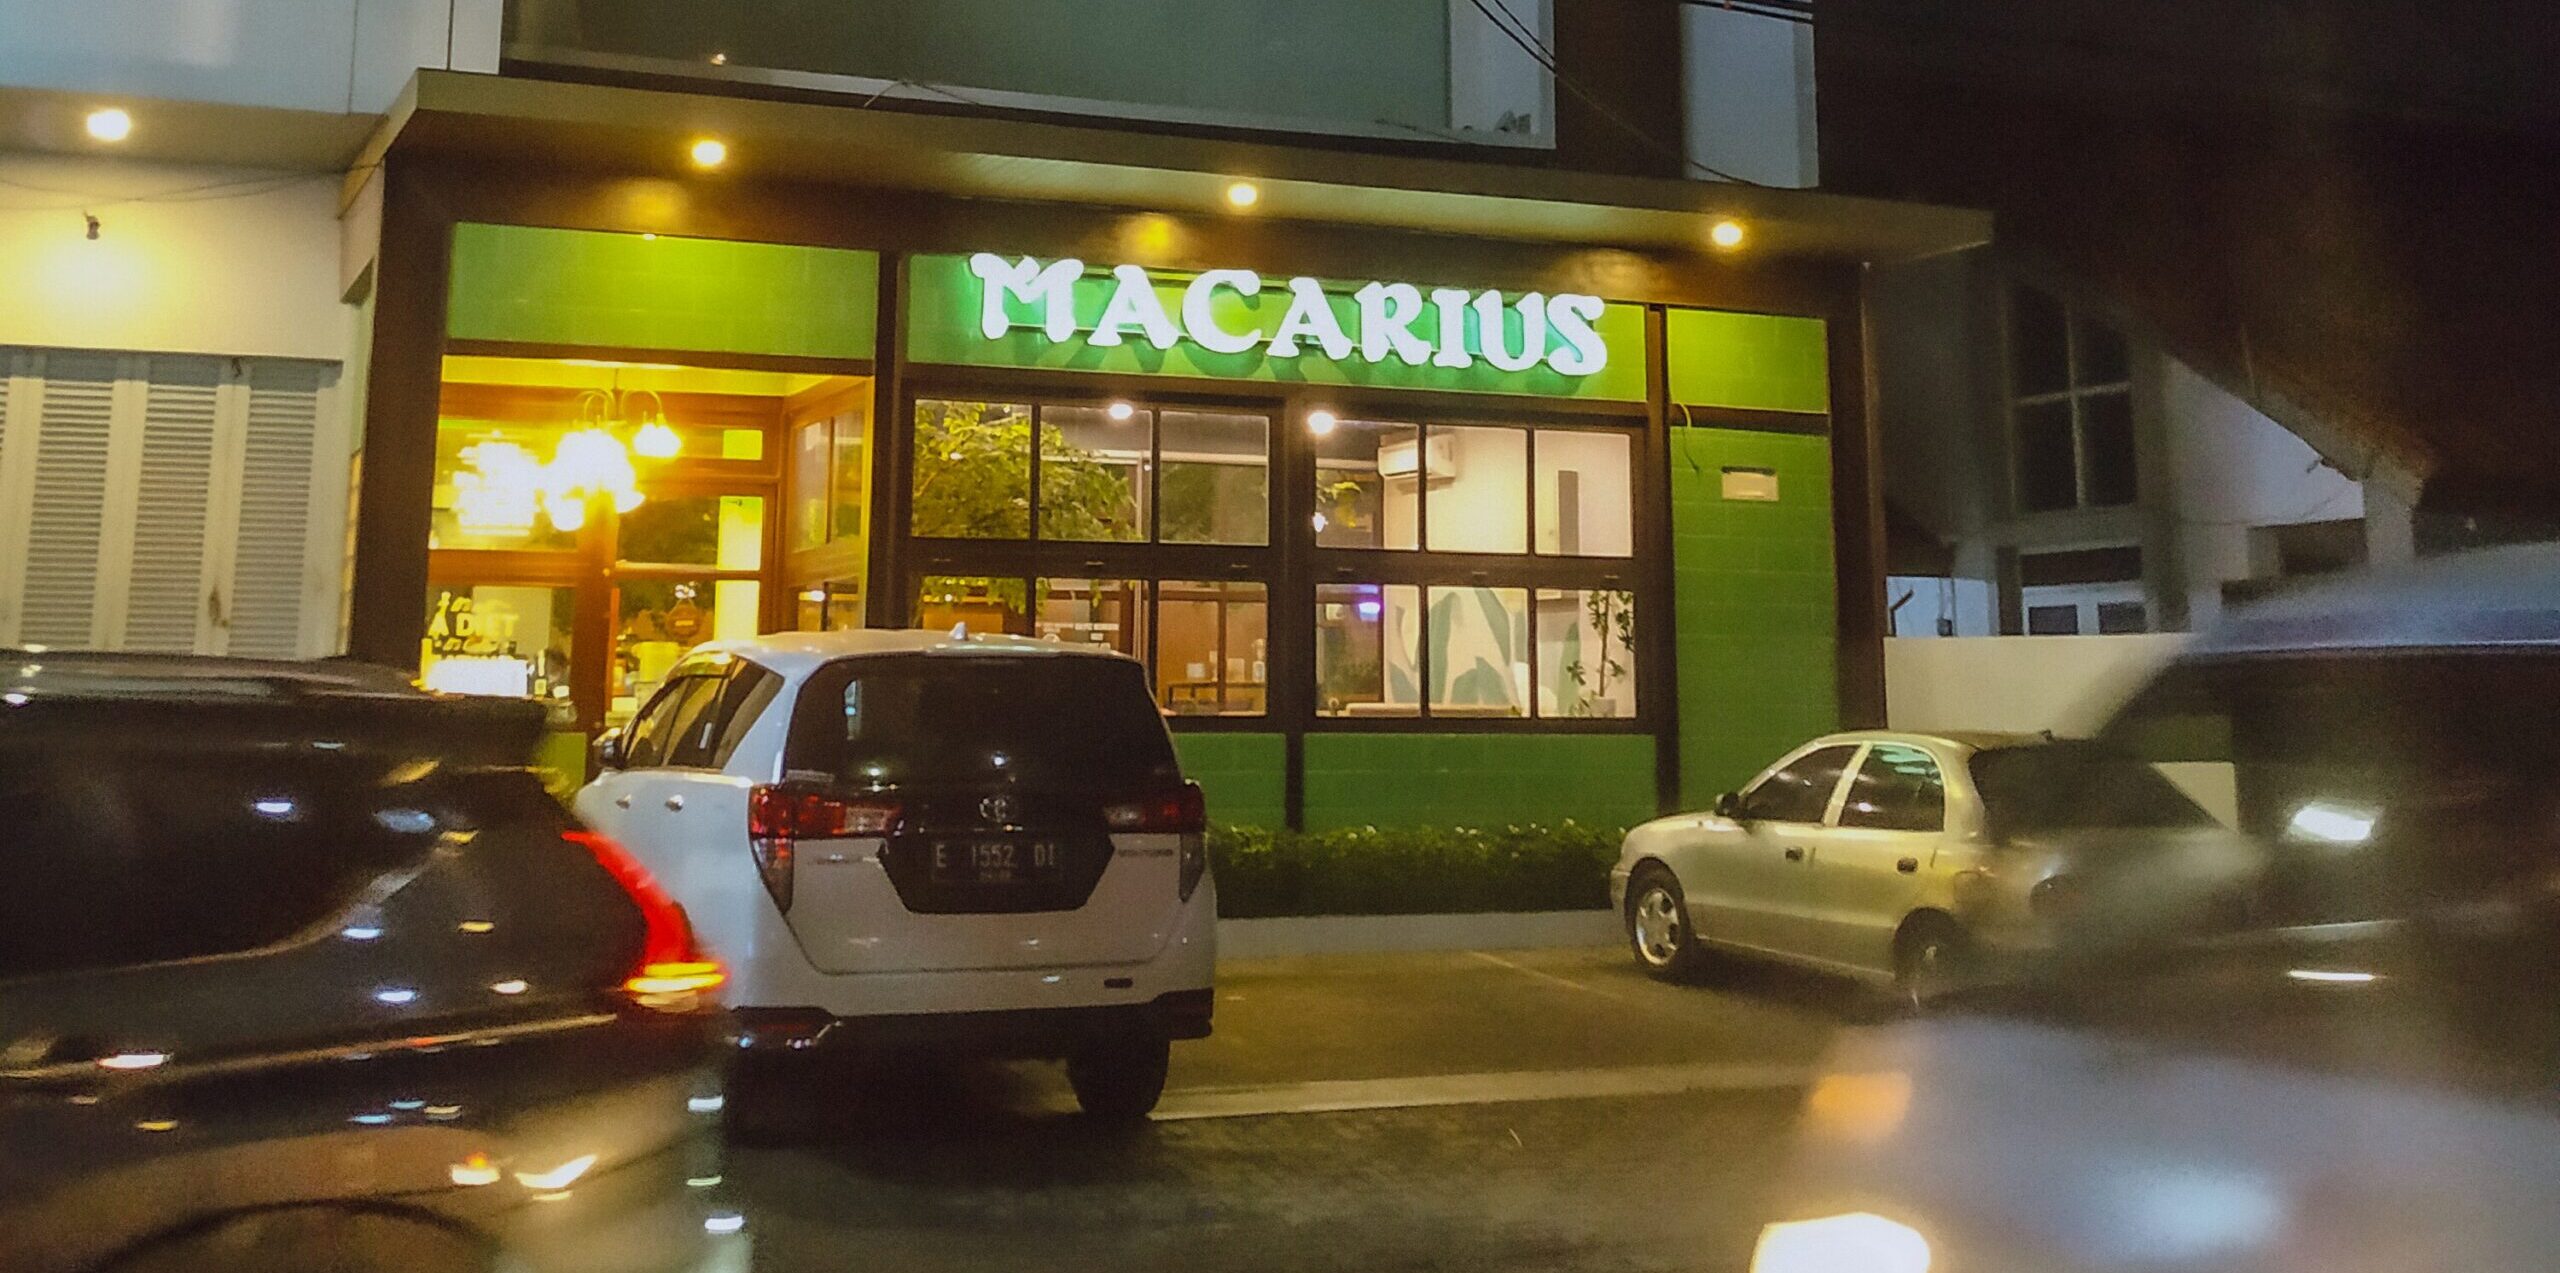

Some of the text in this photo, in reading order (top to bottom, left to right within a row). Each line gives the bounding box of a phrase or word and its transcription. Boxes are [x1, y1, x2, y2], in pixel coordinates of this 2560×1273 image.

[970, 252, 1608, 377] MACARIUS
[936, 843, 947, 868] E
[972, 843, 1017, 868] 1552
